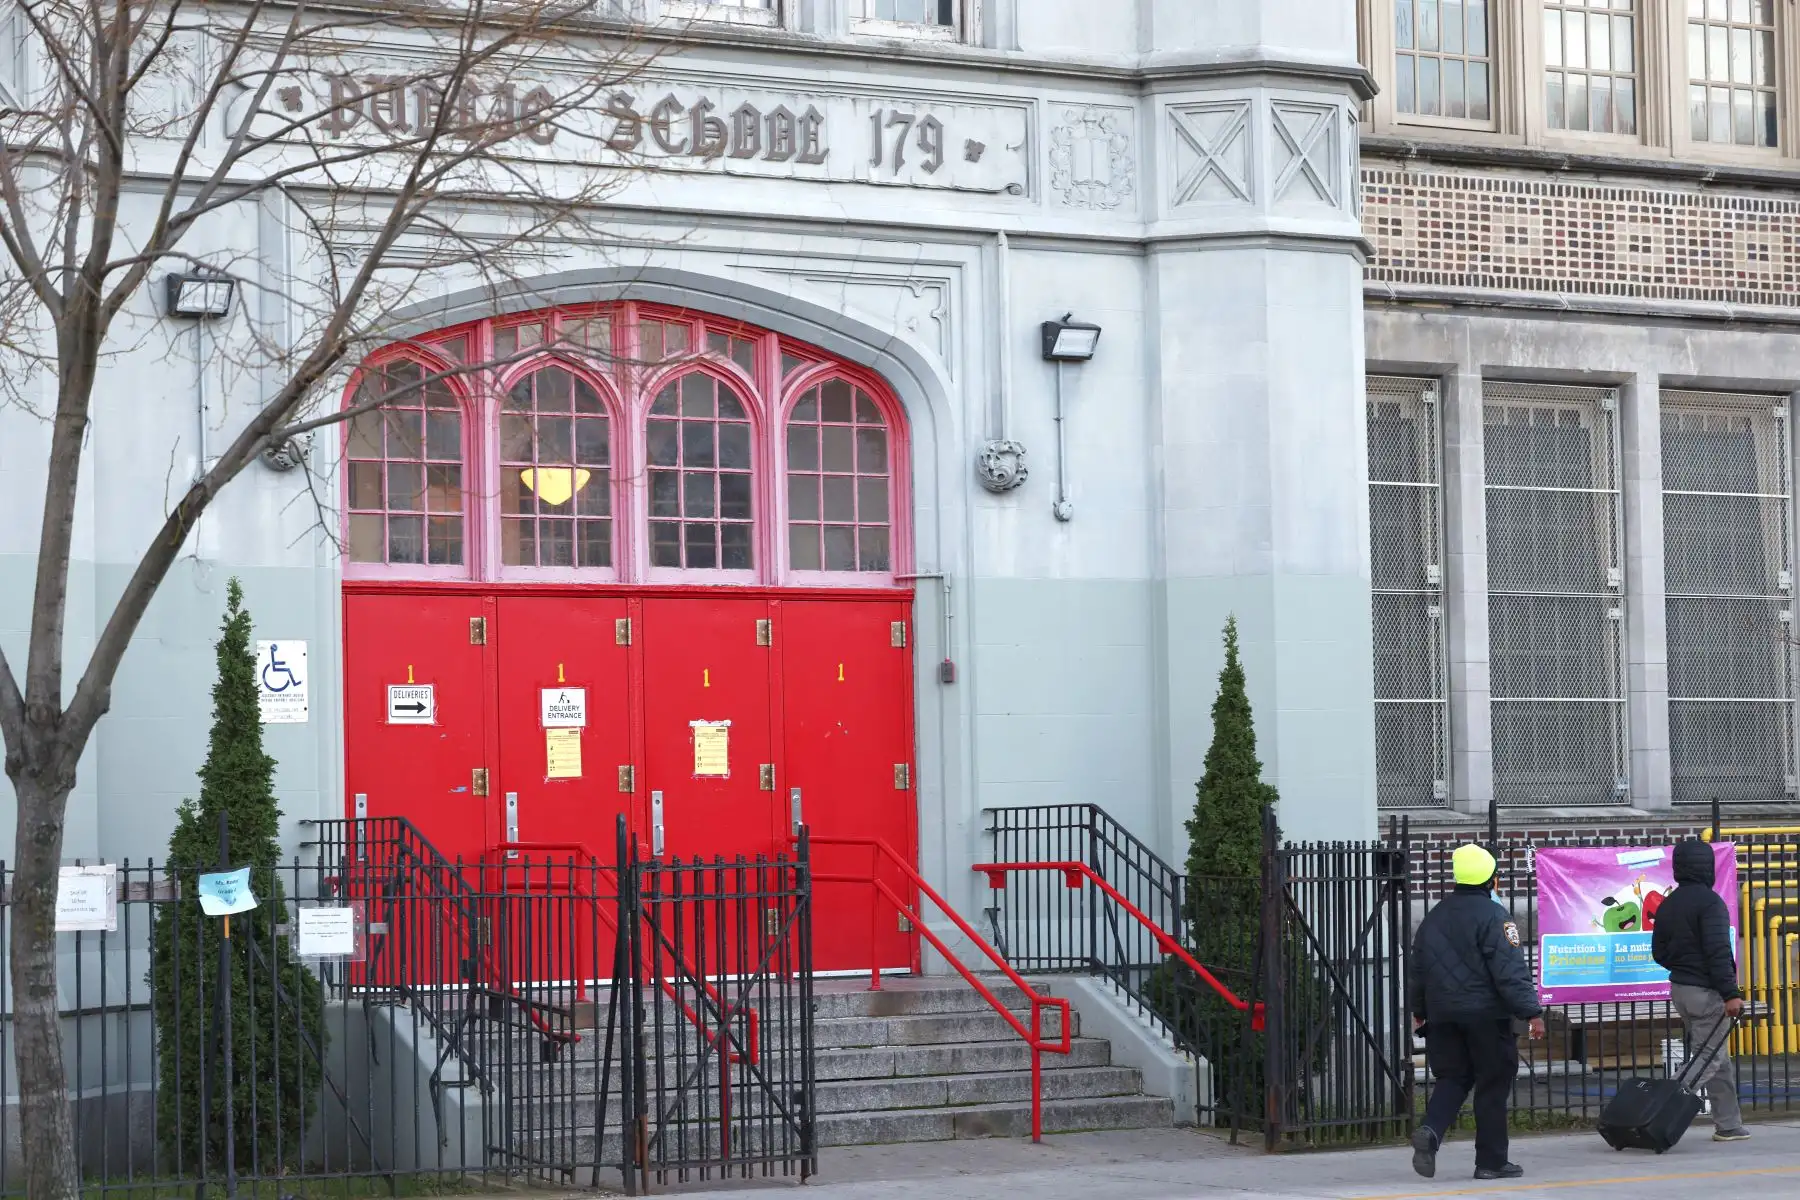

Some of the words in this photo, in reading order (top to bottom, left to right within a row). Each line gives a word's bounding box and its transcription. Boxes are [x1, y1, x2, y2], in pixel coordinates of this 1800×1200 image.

[869, 108, 944, 176] 179
[407, 664, 415, 684] 1
[557, 663, 566, 683] 1
[703, 668, 710, 687] 1
[838, 663, 845, 681] 1
[393, 690, 429, 699] DELIVERIES
[1548, 944, 1596, 954] Nutrition
[1597, 943, 1607, 953] is
[1614, 943, 1628, 953] La
[1615, 955, 1626, 963] no
